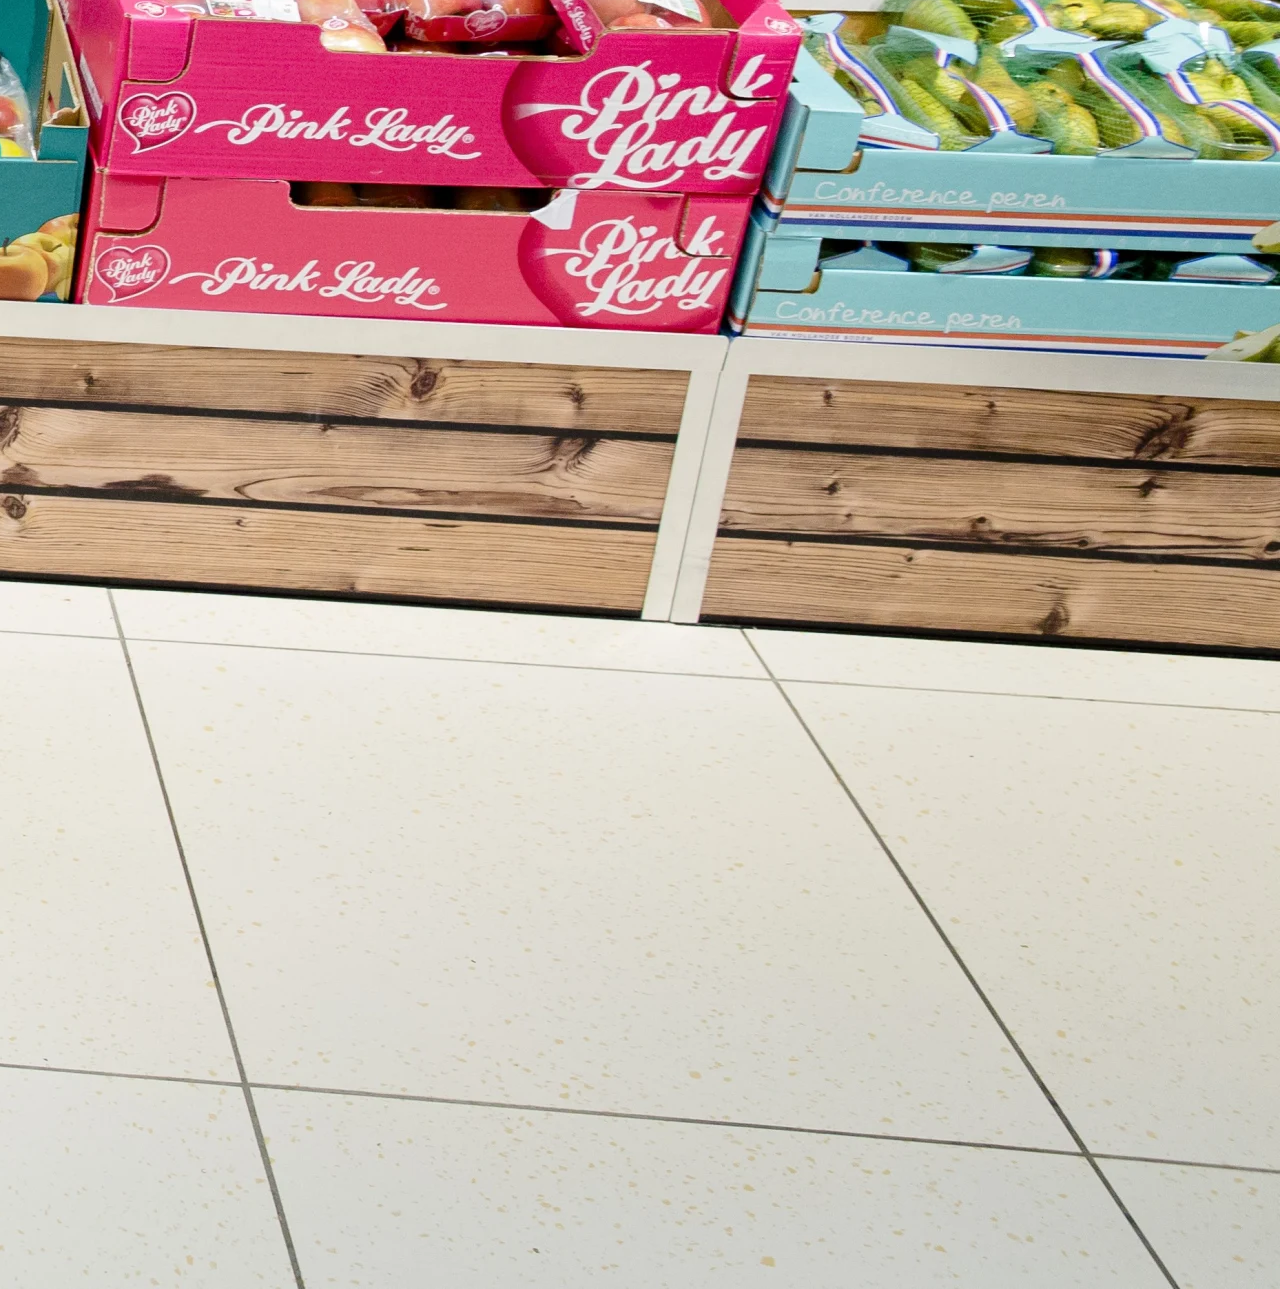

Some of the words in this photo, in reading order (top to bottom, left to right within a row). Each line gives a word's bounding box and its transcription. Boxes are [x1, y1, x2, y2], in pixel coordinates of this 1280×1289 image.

[128, 100, 178, 127] Pink
[550, 54, 774, 140] Pink
[134, 114, 182, 137] Lady
[205, 103, 352, 144] Pink
[348, 107, 481, 160] Lady
[567, 112, 768, 189] Lady
[814, 181, 977, 205] Conference
[986, 190, 1066, 213] peren
[105, 253, 152, 279] Pink
[552, 215, 725, 277] Pink
[112, 268, 158, 288] Lady
[192, 257, 322, 295] Pink
[318, 261, 448, 310] Lady
[576, 258, 732, 316] Lady
[775, 300, 936, 325] Conference
[944, 310, 1021, 334] peren
